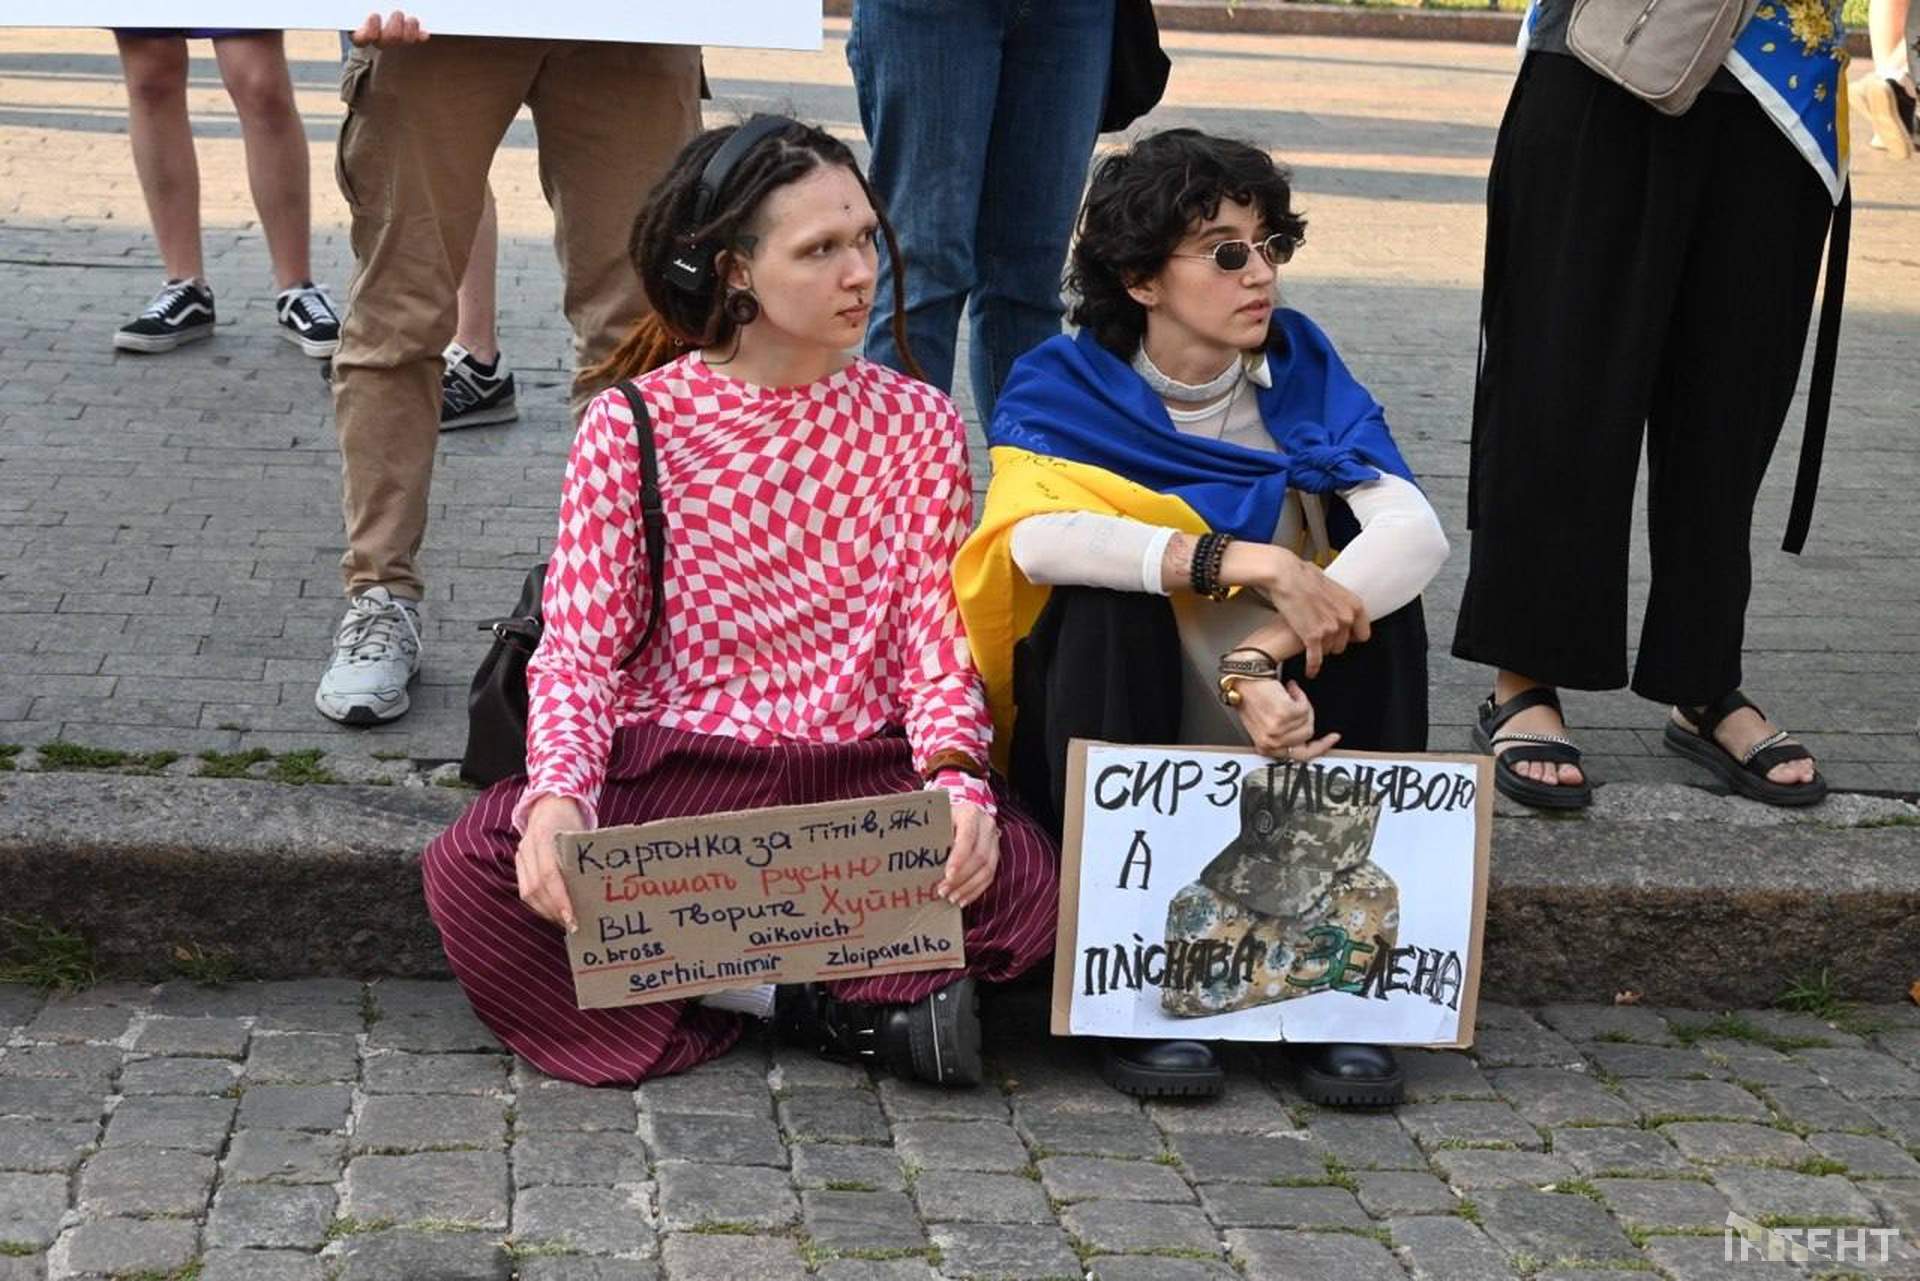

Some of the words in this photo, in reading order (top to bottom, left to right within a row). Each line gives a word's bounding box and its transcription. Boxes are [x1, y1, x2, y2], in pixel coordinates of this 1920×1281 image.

[1095, 759, 1203, 816] СИР
[1205, 760, 1241, 807] З
[576, 834, 742, 876] Картонка
[745, 831, 792, 867] за
[601, 871, 738, 902] їбашать
[888, 846, 952, 872] поки
[1116, 830, 1152, 890] А
[670, 900, 804, 932] творите
[826, 935, 951, 968] zloipavelko
[1285, 925, 1462, 1011] ЗЕЛЕНА
